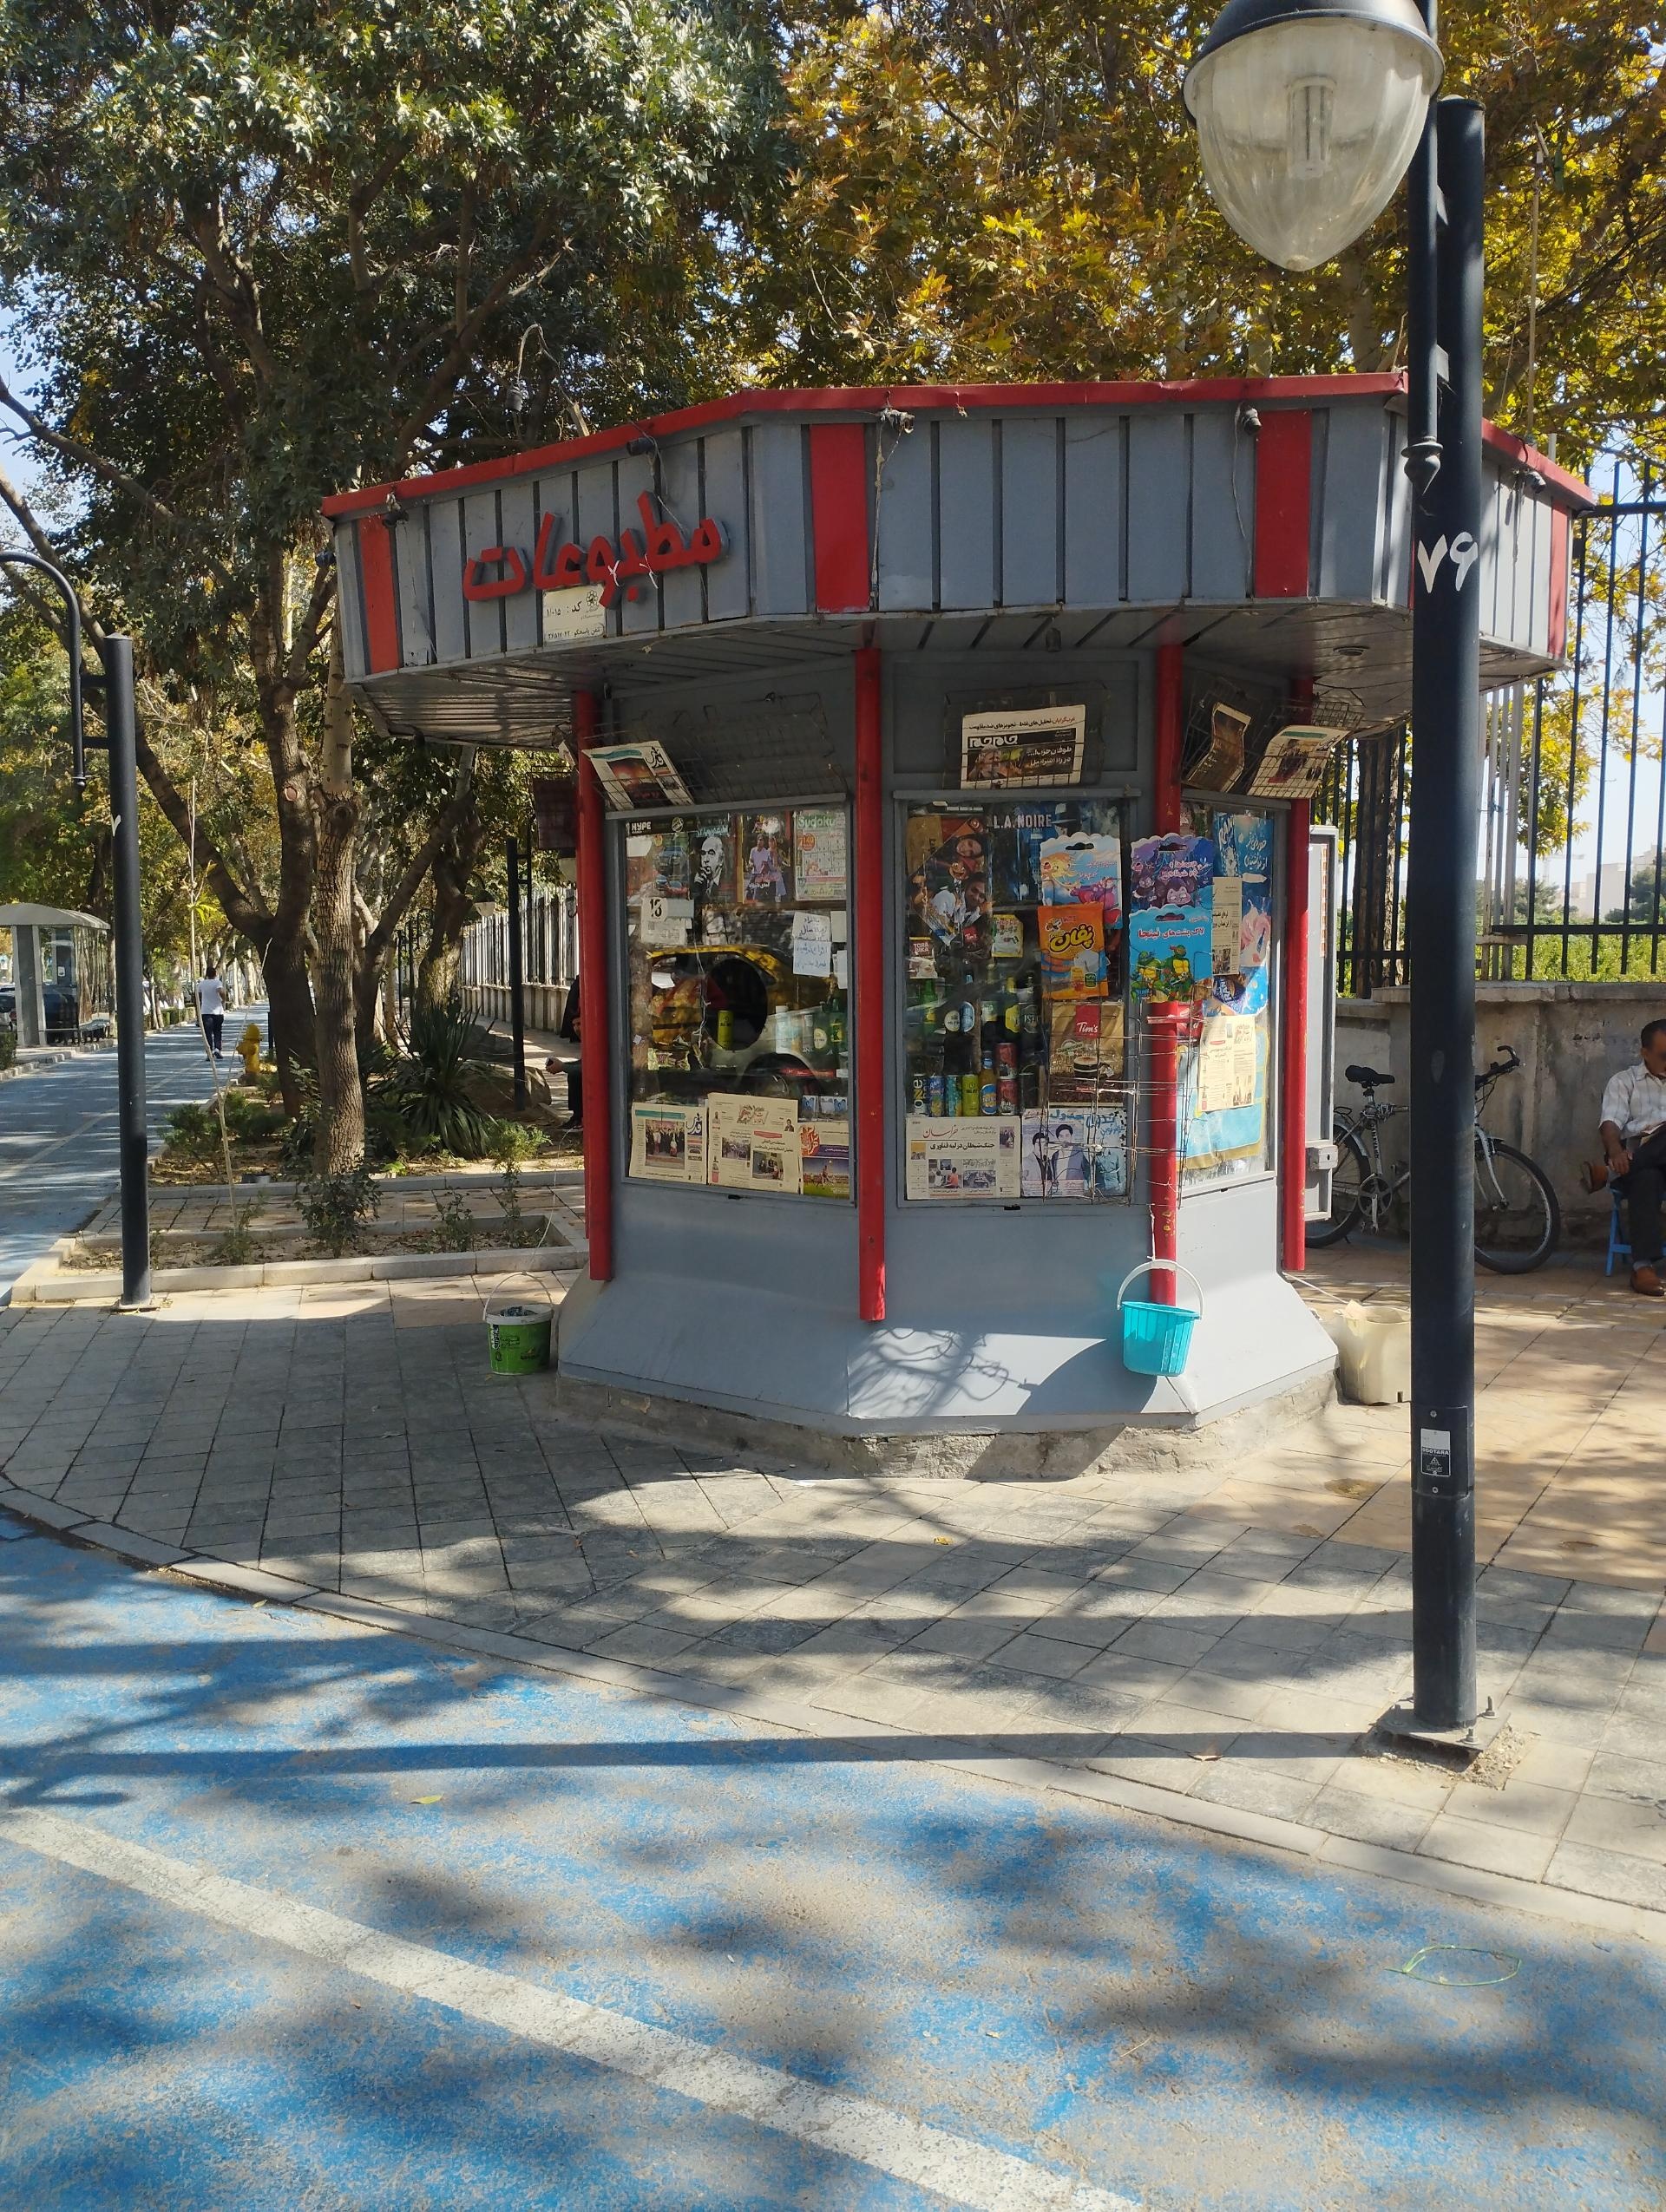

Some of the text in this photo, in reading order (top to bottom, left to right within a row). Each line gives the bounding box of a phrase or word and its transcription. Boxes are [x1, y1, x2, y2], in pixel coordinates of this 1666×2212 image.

[462, 490, 725, 609] مطبوعات
[1017, 814, 1053, 828] NOIRE
[1076, 1021, 1099, 1033] Tim's
[922, 1123, 959, 1139] خراسان
